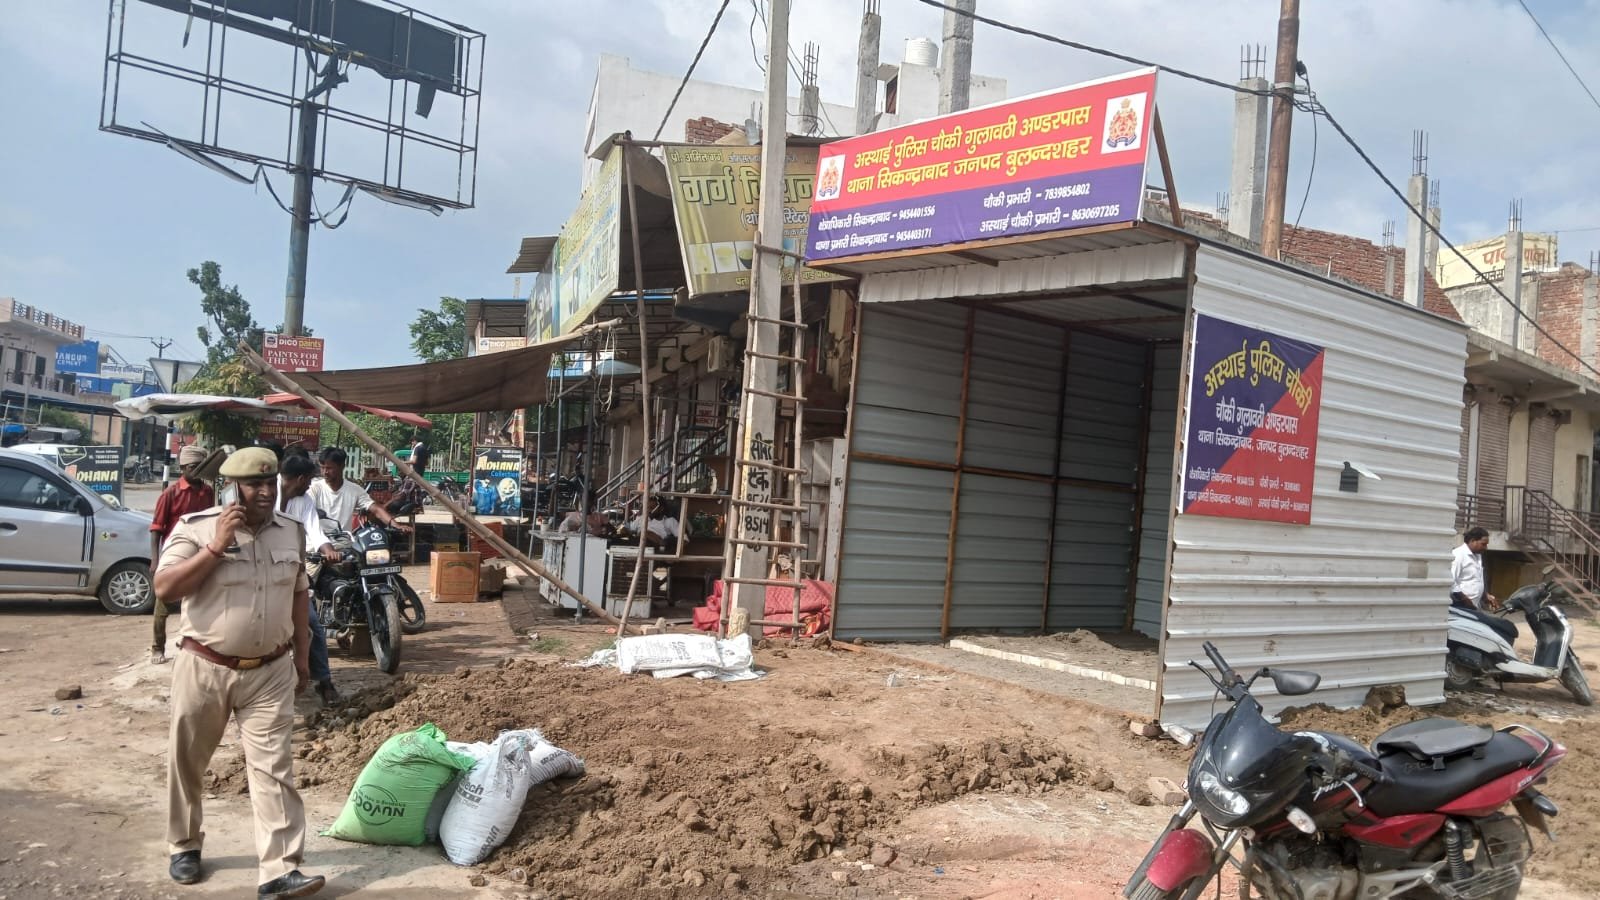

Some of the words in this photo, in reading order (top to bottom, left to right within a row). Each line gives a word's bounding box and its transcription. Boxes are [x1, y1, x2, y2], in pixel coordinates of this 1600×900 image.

[854, 140, 893, 168] अस्थाई
[893, 136, 928, 167] पुलिस
[931, 125, 962, 152] चौकी
[965, 114, 1017, 154] गुलावठी
[1020, 105, 1091, 136] अण्डरपास
[847, 176, 874, 193] थाना
[877, 162, 950, 189] सिकन्द्राबाद
[954, 152, 1003, 176] जनपद
[1006, 136, 1092, 176] बुलन्दशहर
[679, 166, 736, 205] गर्ग
[984, 191, 1004, 208] चौकी
[1006, 187, 1031, 207] प्रभारी
[1044, 183, 1090, 200] 7839854802
[980, 213, 1009, 232] अस्थाई
[1011, 211, 1032, 228] चौकी
[1035, 207, 1060, 227] प्रभारी
[1071, 204, 1119, 221] 8630697205
[267, 349, 298, 359] PAINTS
[299, 352, 318, 360] FOR
[267, 356, 288, 365] THE
[290, 358, 319, 367] WALL
[1204, 339, 1247, 397] अस्थाई
[1250, 341, 1285, 386] पुलिस
[1285, 367, 1312, 415] चौकी
[1216, 396, 1235, 423] चौकी
[1256, 439, 1277, 453] जनपद
[745, 515, 769, 534] 8514
